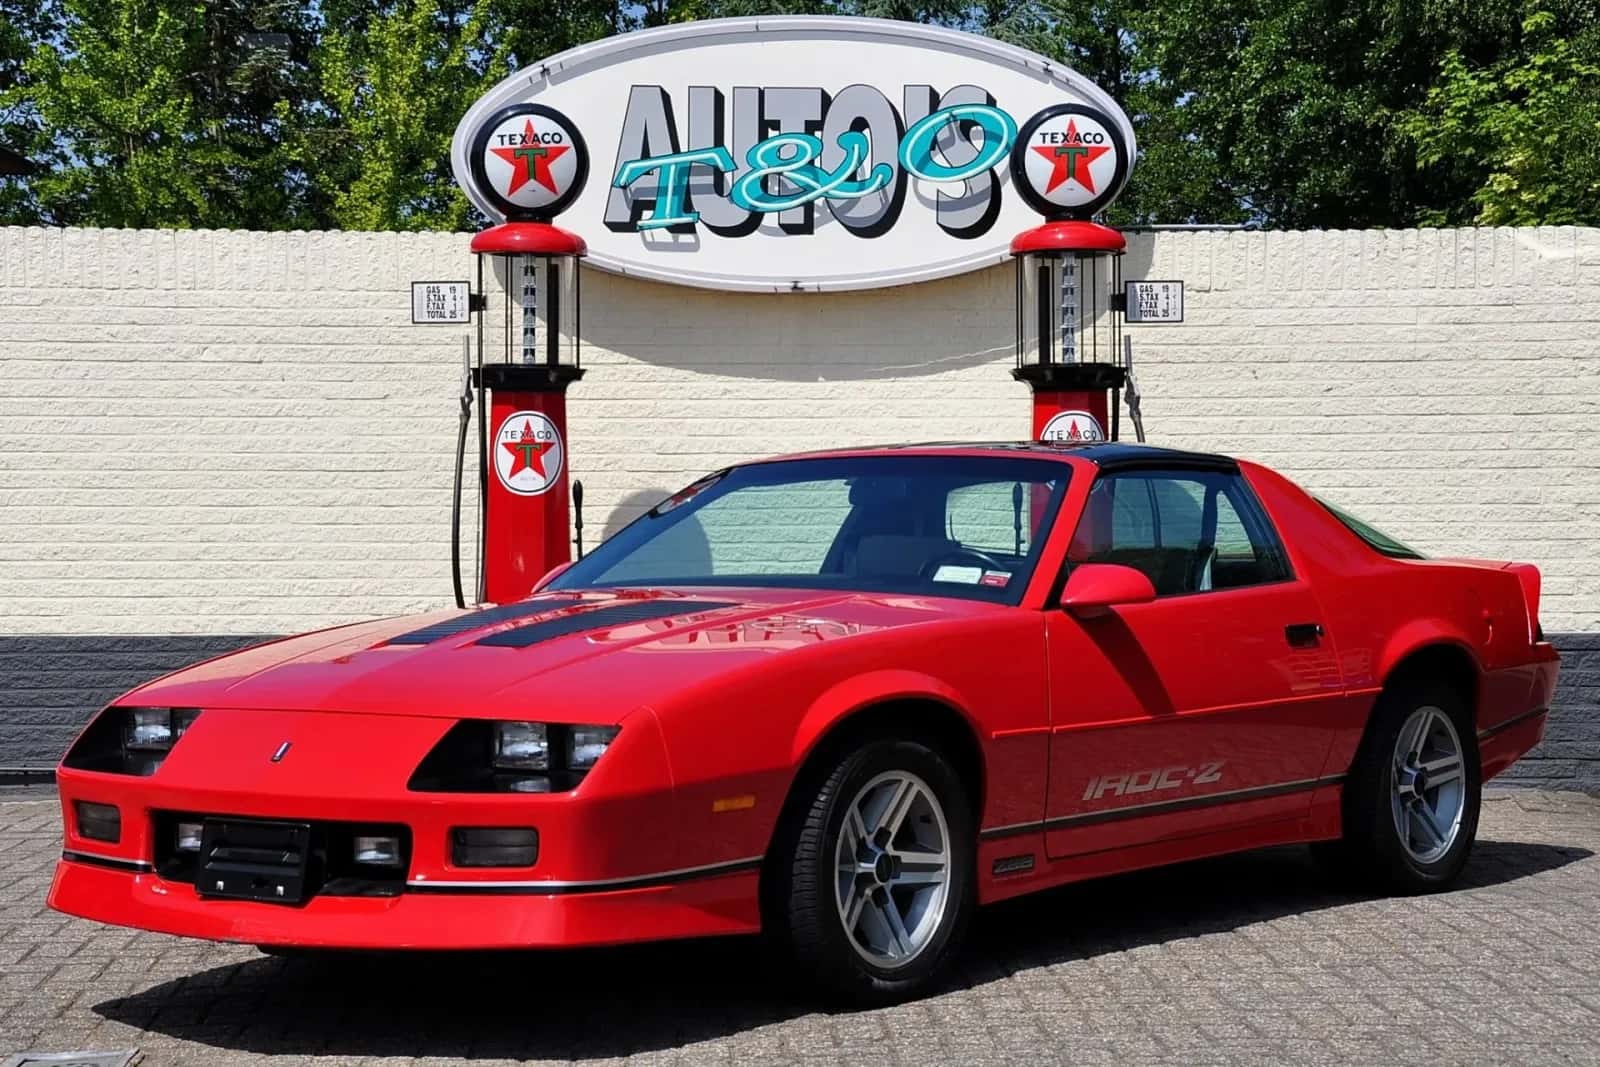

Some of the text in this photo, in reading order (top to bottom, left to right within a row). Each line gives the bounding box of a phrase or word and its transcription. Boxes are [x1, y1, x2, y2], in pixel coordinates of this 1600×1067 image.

[497, 132, 563, 145] TEXACO
[1040, 132, 1104, 144] TEXACO
[514, 148, 548, 180] T
[603, 84, 1001, 239] AUTO'S
[1055, 147, 1088, 178] T
[426, 311, 447, 319] TOTAL
[503, 430, 552, 440] TEXACO
[1049, 430, 1097, 440] TEXACO
[516, 444, 541, 467] T
